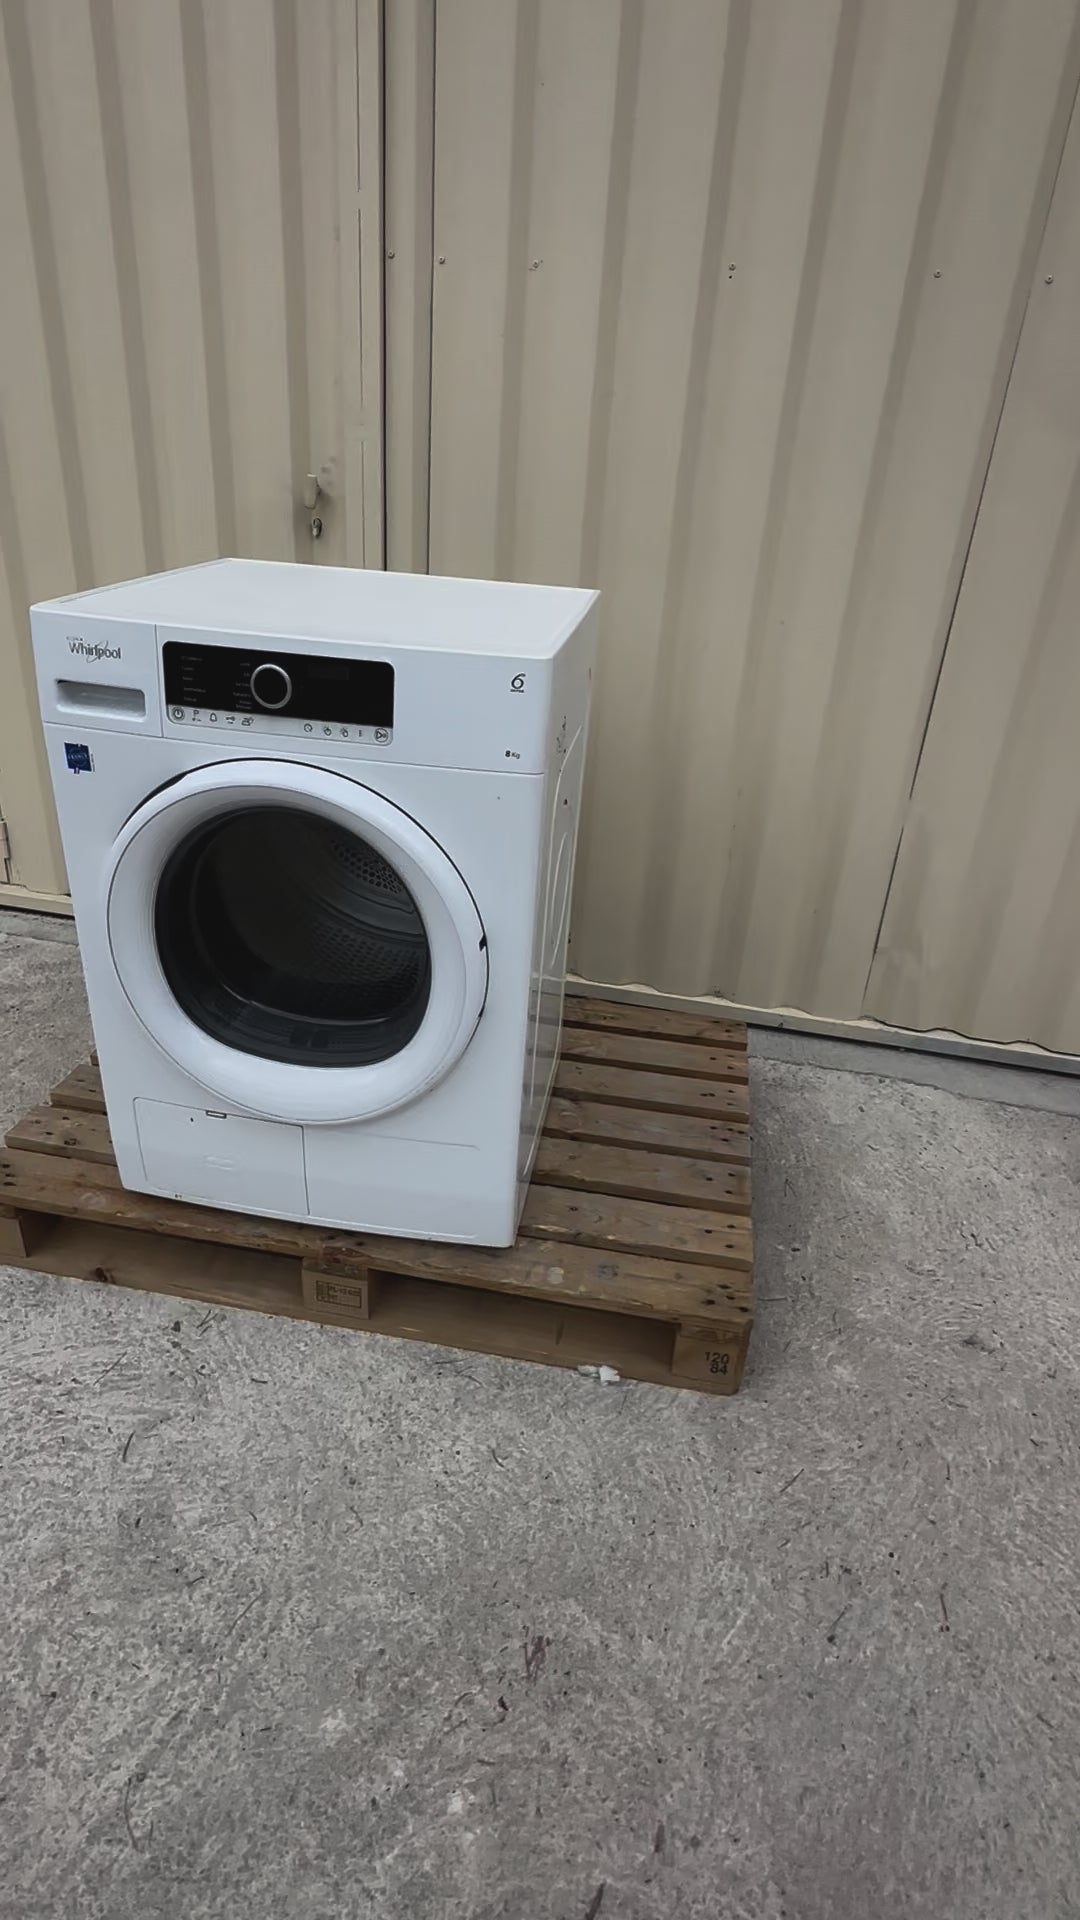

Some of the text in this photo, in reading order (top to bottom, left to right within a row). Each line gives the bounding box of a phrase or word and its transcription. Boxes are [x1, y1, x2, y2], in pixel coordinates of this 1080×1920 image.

[68, 640, 121, 663] Whirlpool
[511, 673, 526, 689] 6
[505, 750, 511, 758] 8
[705, 1351, 729, 1364] 120
[710, 1362, 728, 1375] 84
